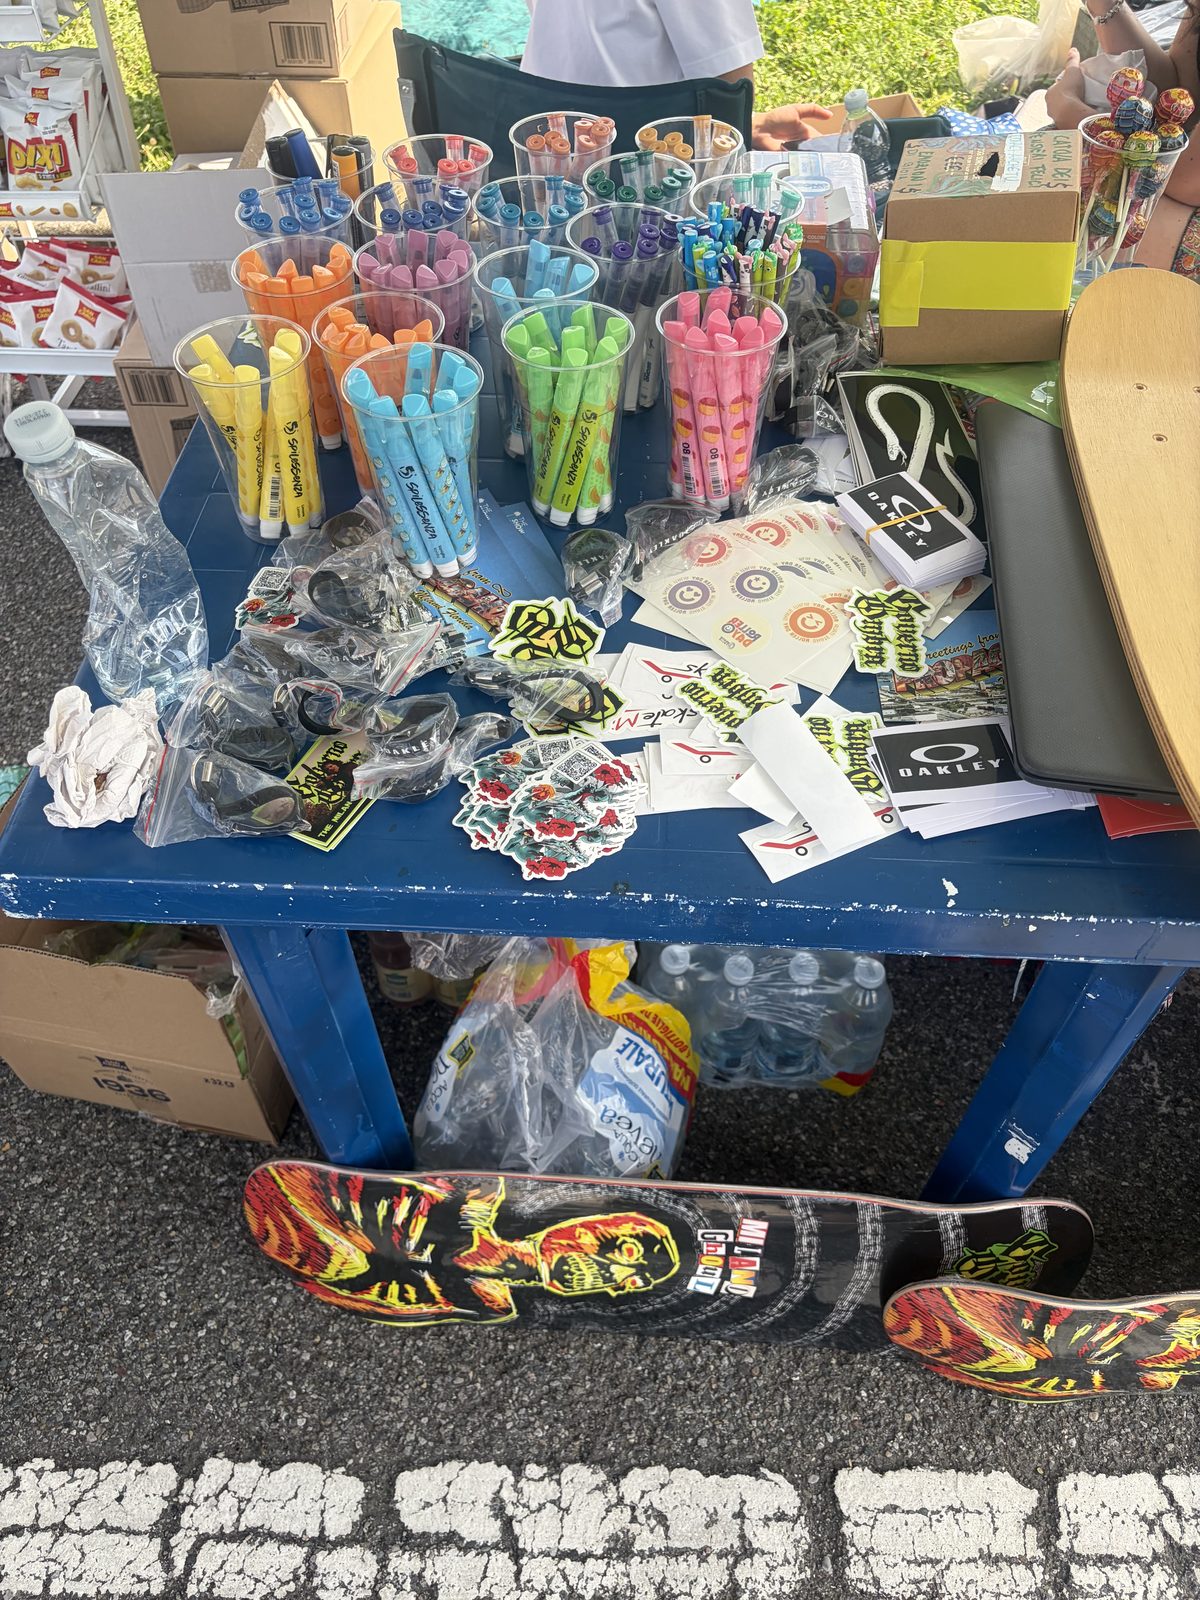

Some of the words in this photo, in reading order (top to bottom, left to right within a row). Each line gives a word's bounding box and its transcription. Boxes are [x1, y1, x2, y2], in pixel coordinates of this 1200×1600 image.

[10, 142, 63, 171] DIXI
[682, 442, 690, 455] 08
[710, 448, 718, 460] 08
[867, 491, 928, 548] OAKLEY
[926, 641, 975, 660] reetings
[899, 758, 1001, 779] OAKLEY
[318, 820, 335, 840] THE
[332, 800, 354, 824] MILAN
[92, 1076, 171, 1103] 1936
[720, 1217, 769, 1299] MILANO
